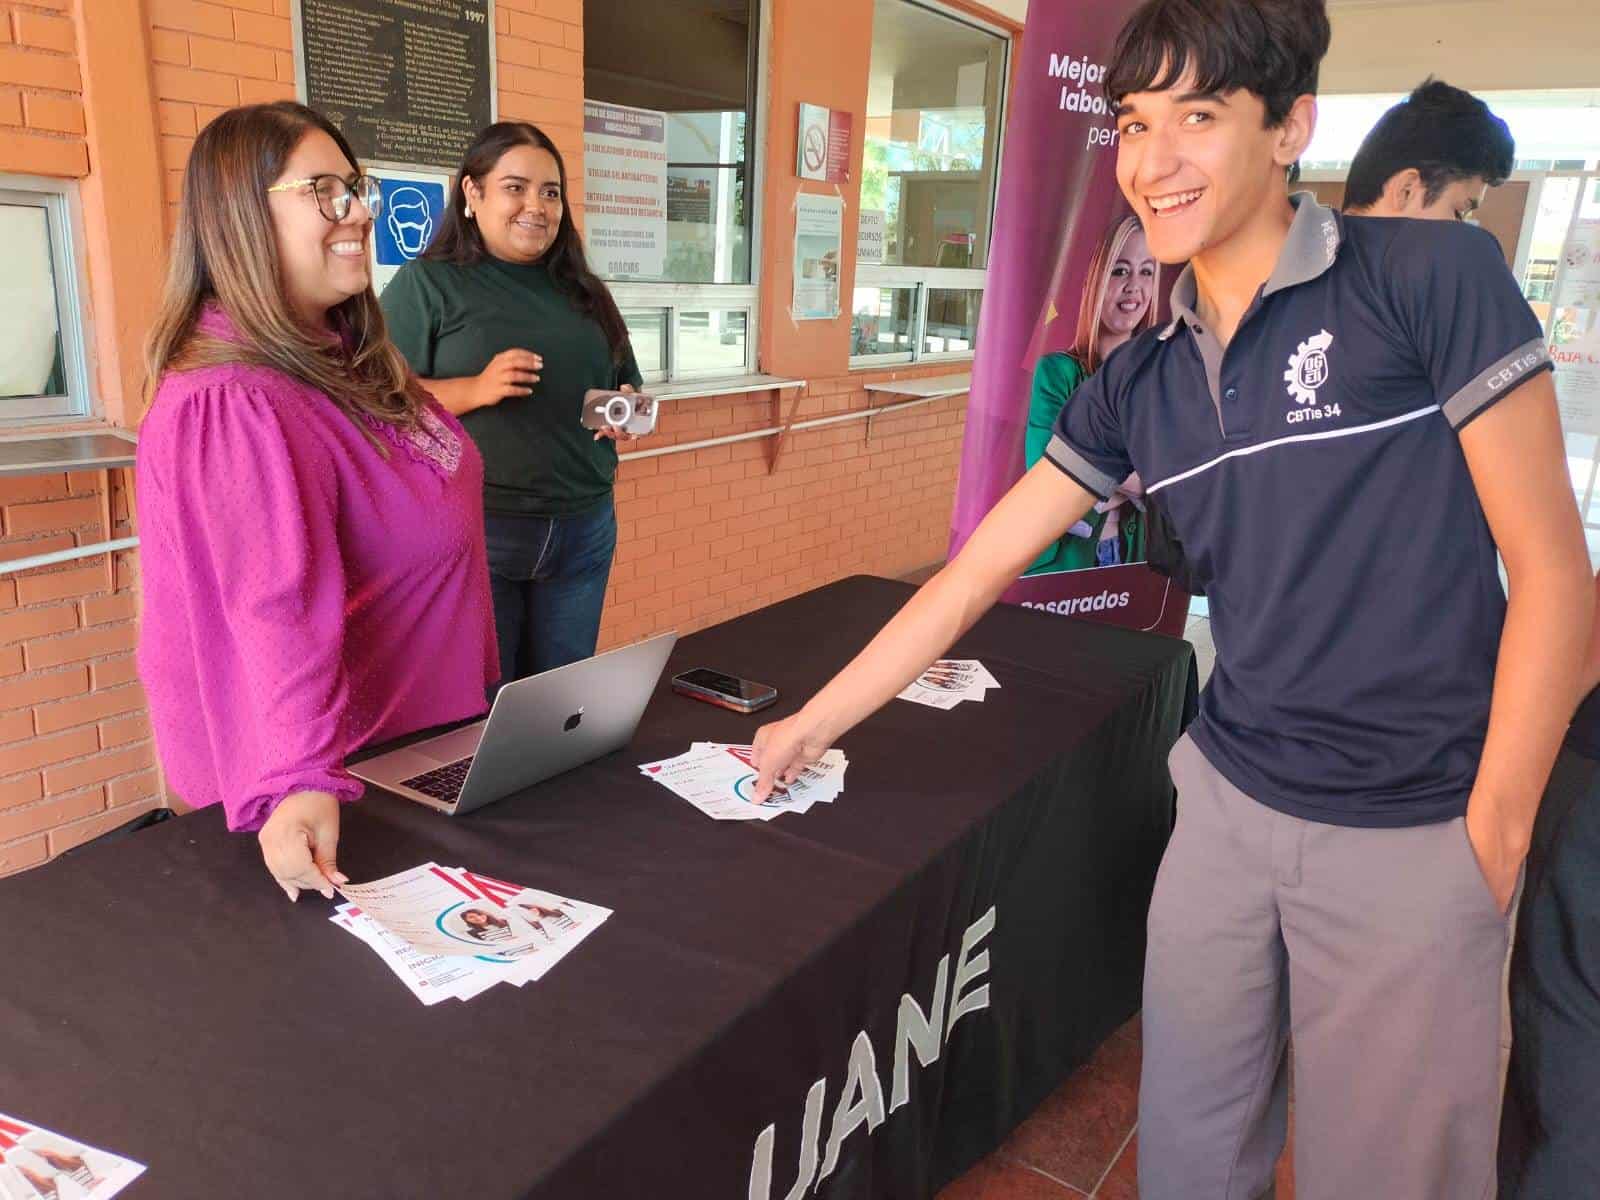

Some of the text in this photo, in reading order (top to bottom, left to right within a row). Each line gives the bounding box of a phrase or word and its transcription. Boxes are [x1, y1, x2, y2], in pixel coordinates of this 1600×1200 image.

[465, 10, 485, 24] 1997
[856, 247, 882, 258] UMANOS
[608, 260, 640, 274] GRACIAS
[1286, 403, 1343, 424] CBTis 34
[748, 904, 997, 1200] UANE
